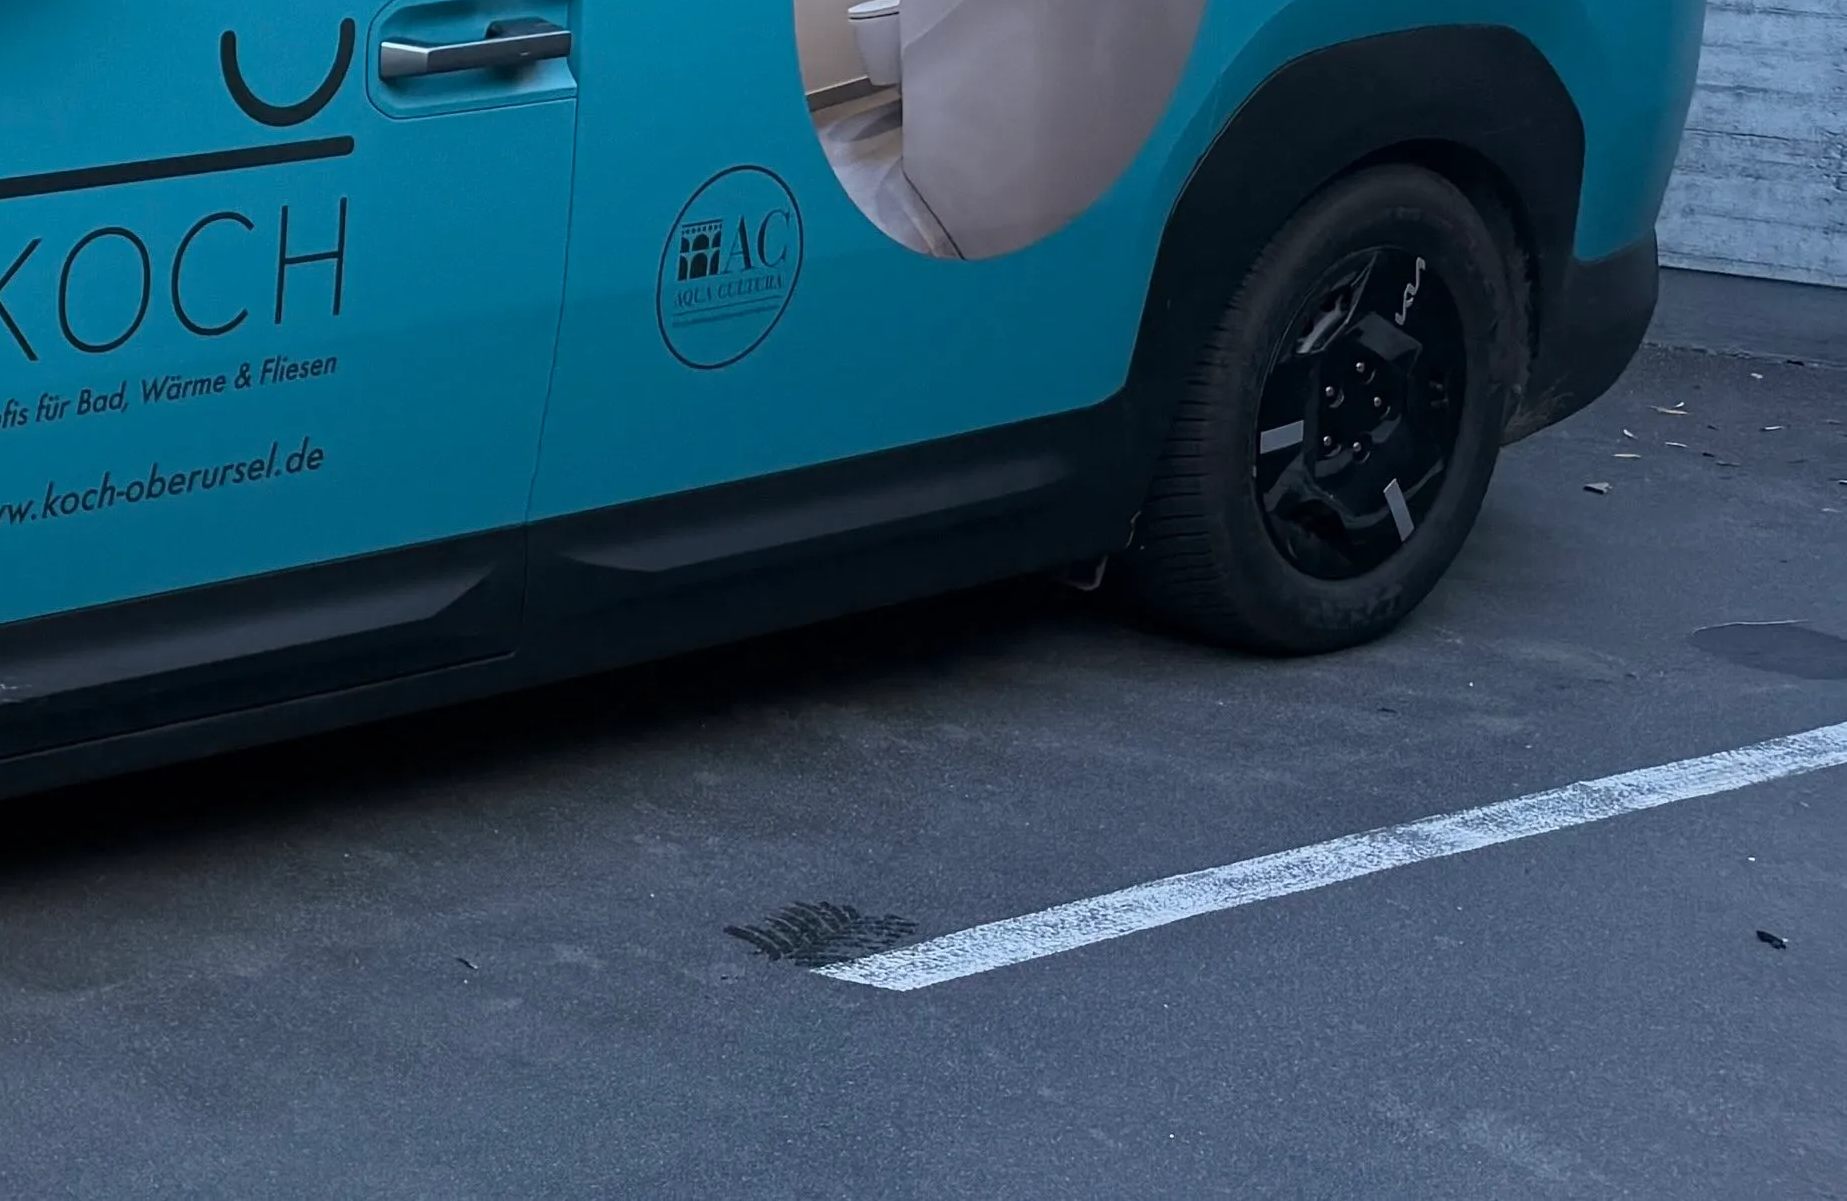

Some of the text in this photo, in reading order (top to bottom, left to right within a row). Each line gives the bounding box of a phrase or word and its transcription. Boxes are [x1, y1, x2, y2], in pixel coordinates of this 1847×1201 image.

[721, 207, 791, 275] AC
[35, 392, 73, 424] für
[75, 380, 129, 416] Bad,
[139, 375, 227, 404] Wärme
[233, 362, 252, 389] &
[259, 354, 339, 386] Fliesen
